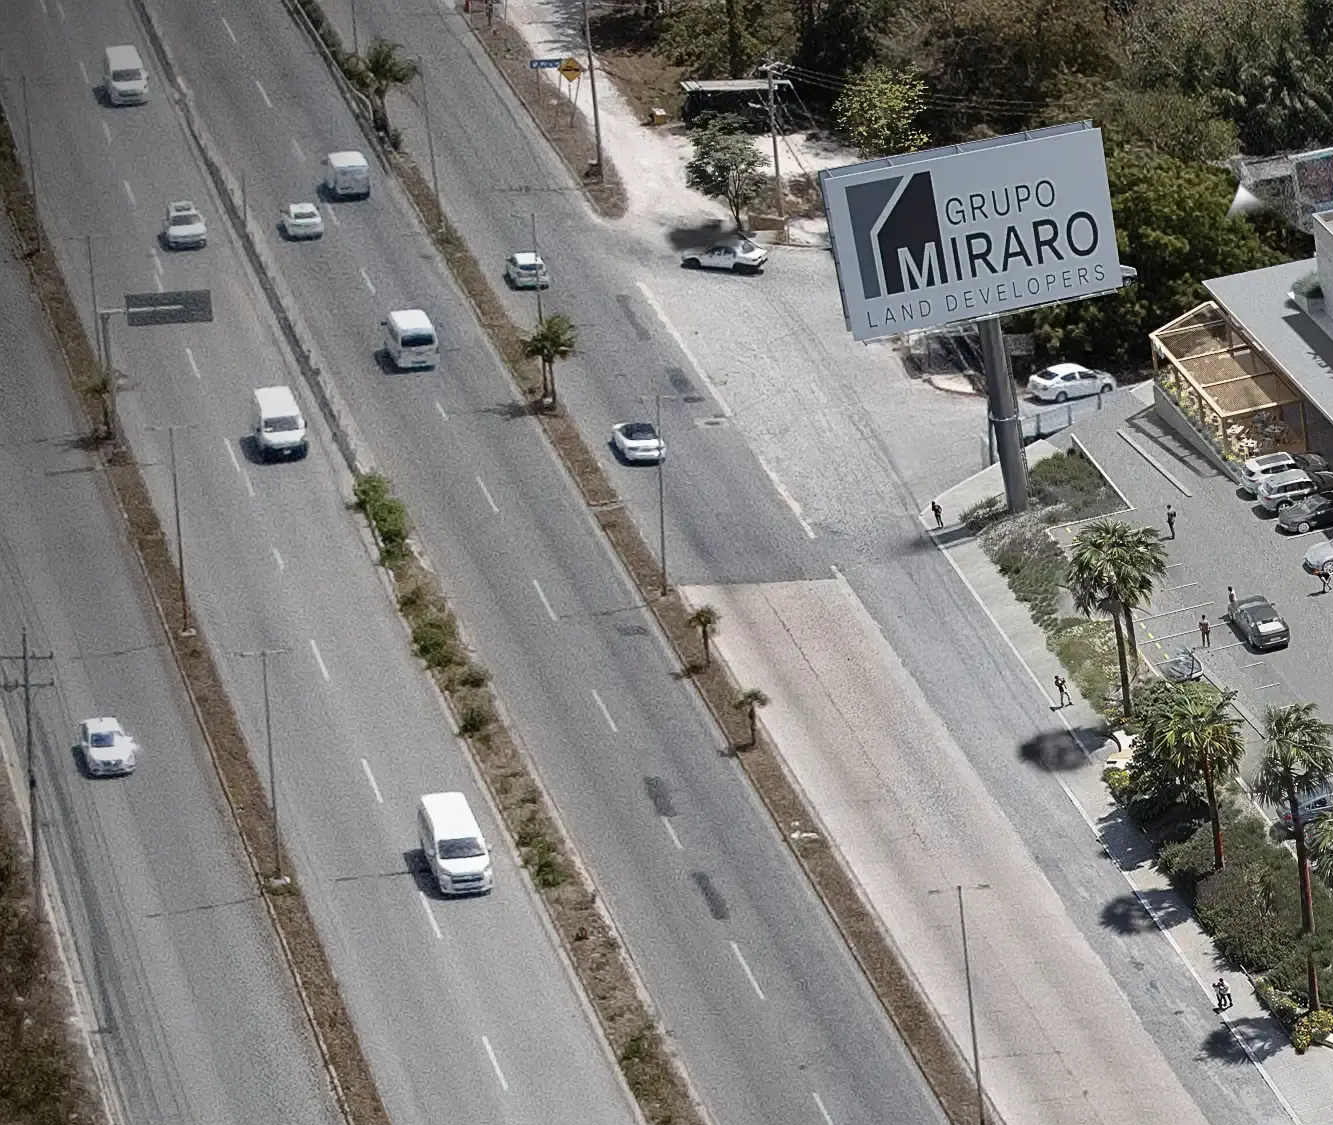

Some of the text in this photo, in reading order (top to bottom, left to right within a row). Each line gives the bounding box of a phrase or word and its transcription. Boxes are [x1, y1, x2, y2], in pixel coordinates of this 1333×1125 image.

[945, 180, 1056, 225] GRUPO
[897, 212, 1099, 292] MIRARO
[867, 264, 1106, 328] LAND DEVELOPERS
